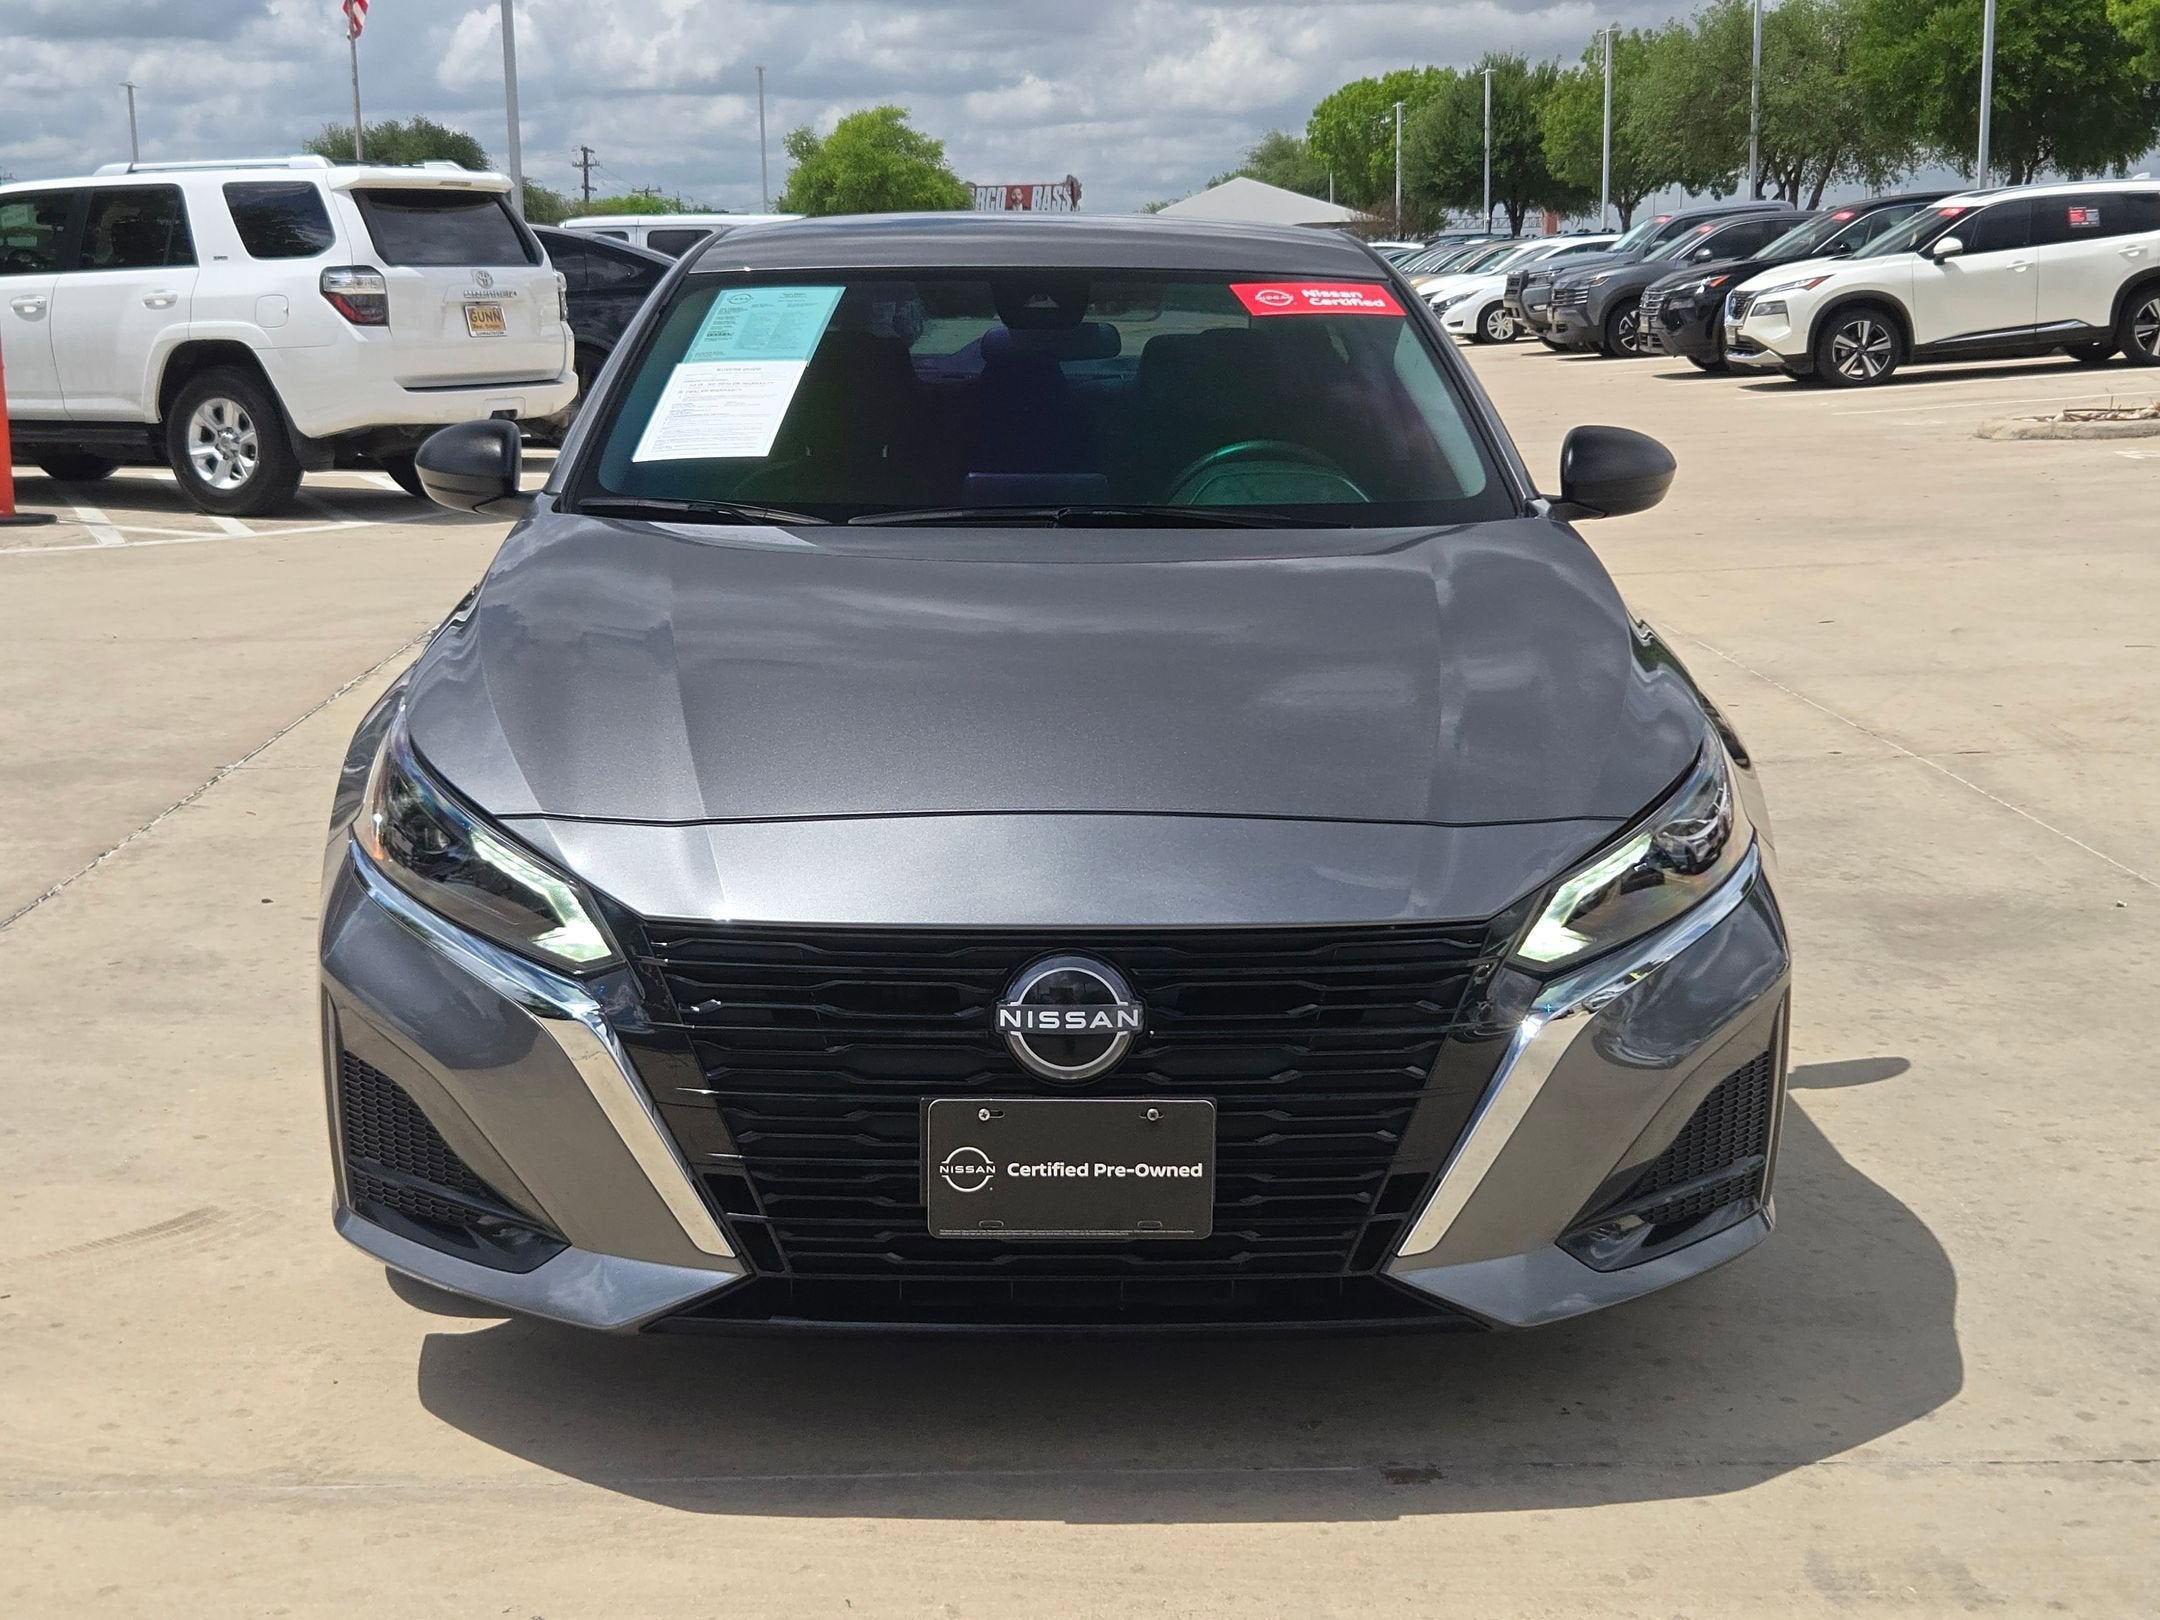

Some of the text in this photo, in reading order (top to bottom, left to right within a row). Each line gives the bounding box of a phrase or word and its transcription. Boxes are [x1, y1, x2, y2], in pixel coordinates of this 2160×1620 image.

[974, 187, 1007, 212] RCO
[1301, 289, 1363, 299] Nissan
[1308, 298, 1387, 307] Certified
[470, 310, 502, 323] GUNN
[999, 1009, 1140, 1029] NISSAN
[939, 1161, 1204, 1178] NISSAN Certified Pre-Owned
